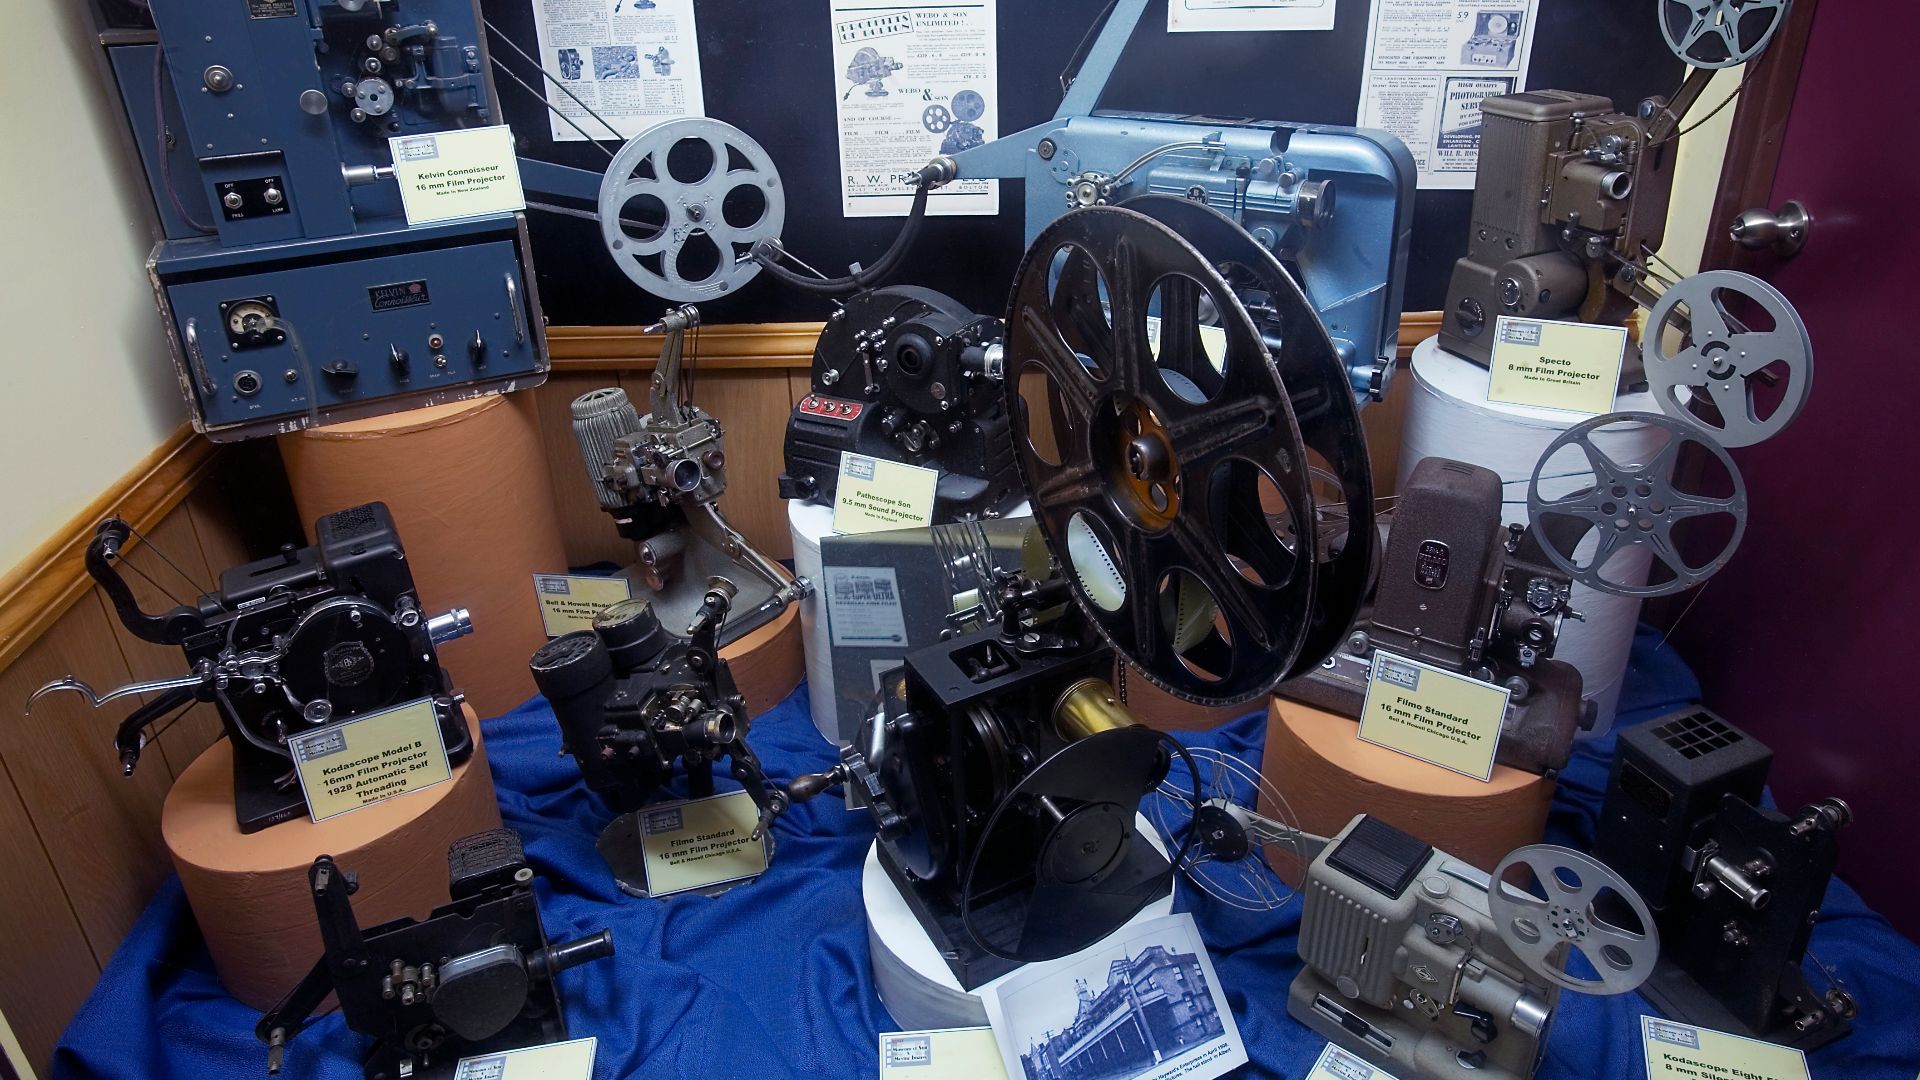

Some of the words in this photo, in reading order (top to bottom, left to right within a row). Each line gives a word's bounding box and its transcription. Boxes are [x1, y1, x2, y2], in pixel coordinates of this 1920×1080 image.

[923, 89, 932, 101] &
[1450, 91, 1503, 100] PHOTOGRAPHIC
[1461, 101, 1480, 110] SERV
[418, 172, 445, 180] Kelvin
[447, 165, 499, 177] Connoisseur
[848, 176, 859, 184] R.
[867, 175, 883, 184] W.
[429, 182, 444, 190] mm
[447, 179, 465, 187] Film
[467, 175, 505, 185] Projector
[375, 288, 406, 298] KELVIN
[1540, 356, 1571, 366] Specto
[1536, 367, 1555, 375] Film
[1558, 370, 1600, 380] Projector
[857, 491, 896, 506] Pathescope
[898, 500, 911, 509] Son
[842, 498, 853, 506] 9.5
[869, 504, 889, 514] Sound
[891, 510, 924, 522] Projector
[1396, 696, 1423, 711] Filmo
[1425, 706, 1468, 726] Standard
[1381, 703, 1392, 712] 16
[1394, 708, 1411, 719] mm
[1414, 713, 1434, 726] Film
[1436, 721, 1482, 741] Projector
[1407, 721, 1426, 731] Howell
[1427, 727, 1450, 739] Chicago
[1450, 736, 1468, 745] U.S.A.
[323, 754, 380, 776] Kodascope
[382, 745, 412, 758] Model
[323, 773, 355, 787] 16mm
[357, 766, 379, 777] Film
[381, 751, 427, 770] Projector
[328, 784, 353, 796] 1928
[356, 768, 407, 788] Automatic
[409, 761, 429, 771] Self
[356, 778, 407, 799] Threading
[363, 796, 379, 804] Made
[388, 789, 405, 797] U.S.A.
[671, 839, 694, 848] Filmo
[697, 829, 735, 842] Standard
[672, 851, 688, 859] mm
[690, 846, 709, 854] Film
[711, 837, 750, 852] Projector
[705, 852, 725, 860] Chicago
[1219, 1048, 1232, 1057] Albert
[1158, 1067, 1180, 1080] Hayward's
[1180, 1056, 1202, 1069] Enterprises
[1664, 1053, 1728, 1073] Kodascope
[1732, 1069, 1763, 1080] Eight
[1676, 1067, 1698, 1076] mm
